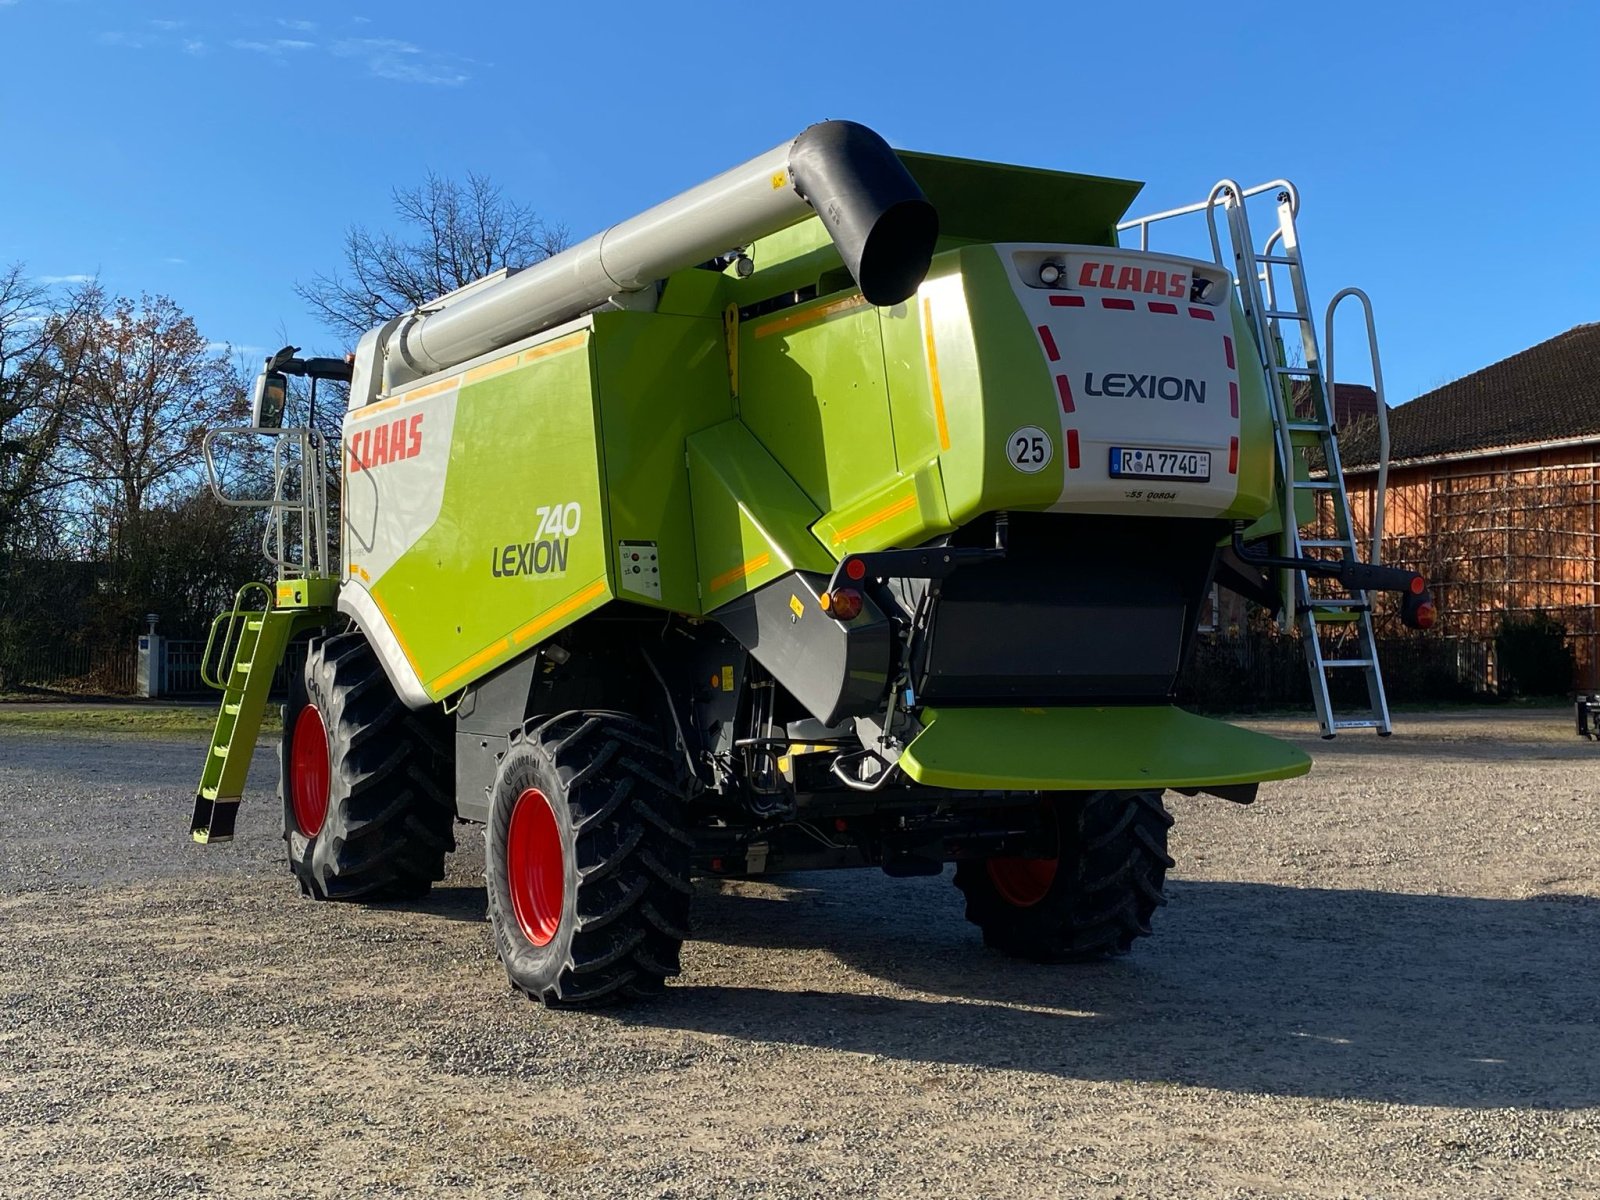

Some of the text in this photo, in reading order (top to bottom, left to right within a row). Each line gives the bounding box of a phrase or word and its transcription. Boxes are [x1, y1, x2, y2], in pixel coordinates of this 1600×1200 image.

[1078, 262, 1187, 298] CLAAS
[1084, 372, 1206, 404] LEXION
[350, 413, 424, 474] CLAAS
[1015, 437, 1045, 464] 25
[1122, 452, 1133, 472] R
[534, 501, 581, 541] 740
[492, 538, 569, 577] LEXION
